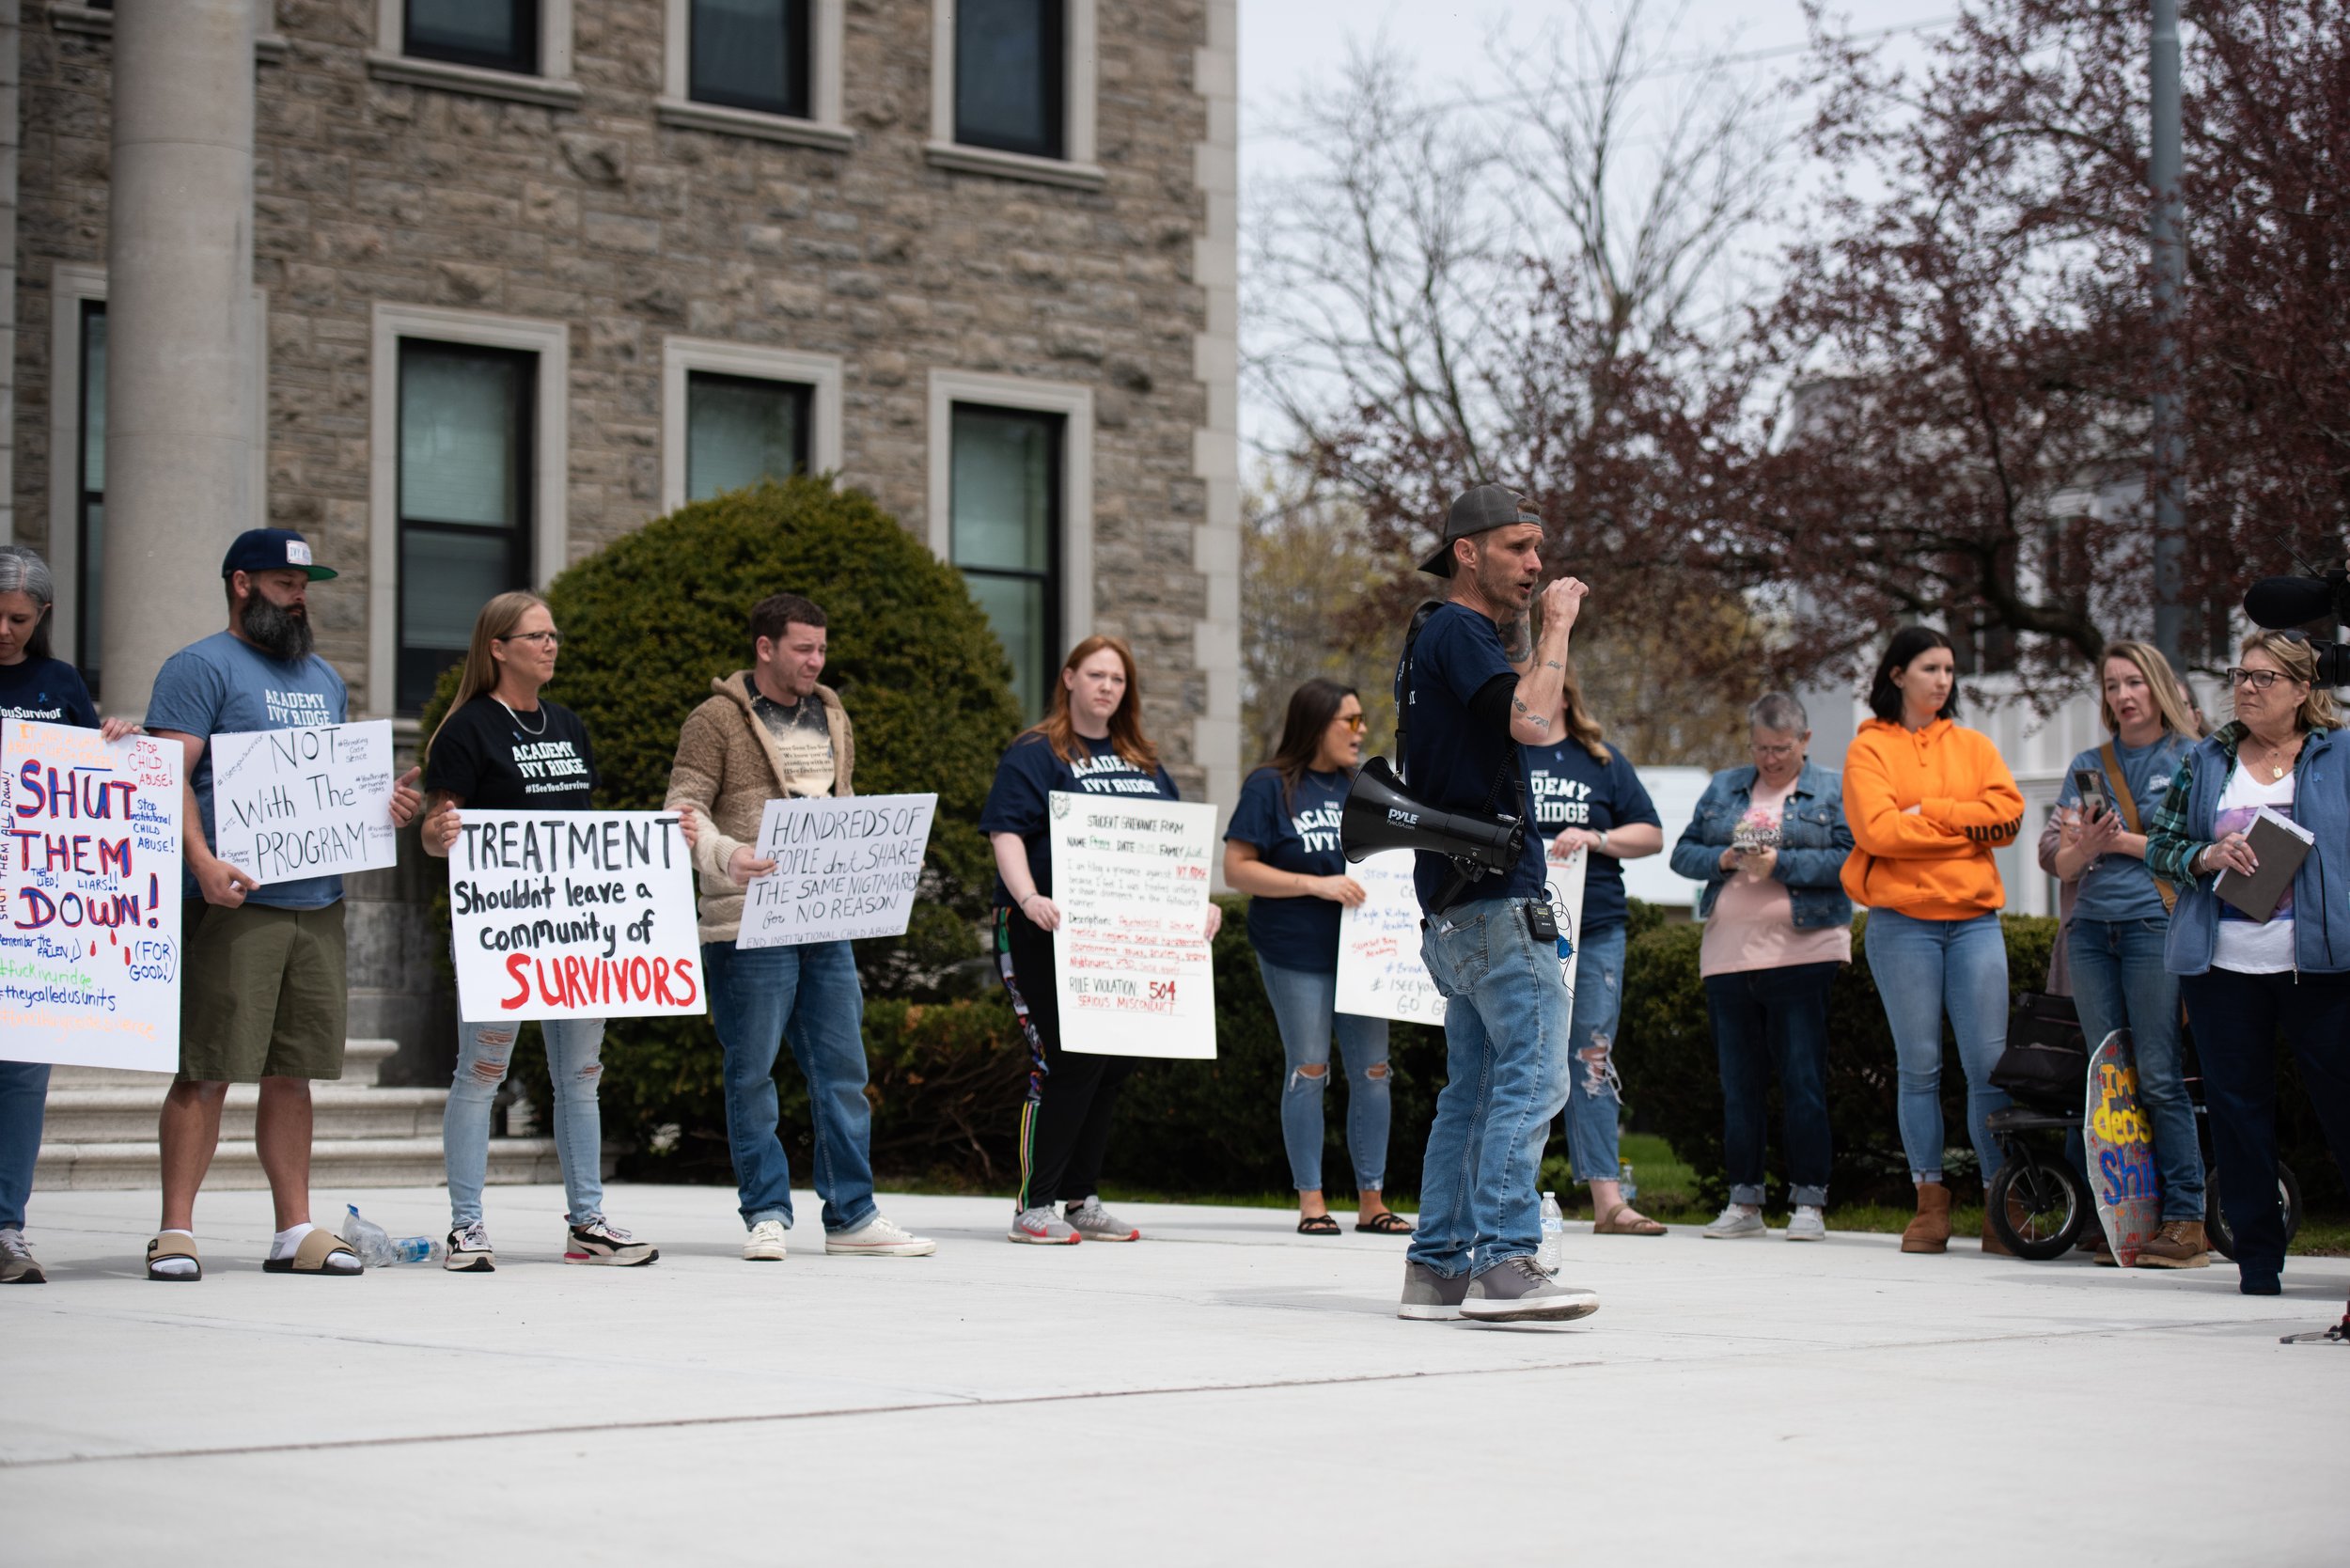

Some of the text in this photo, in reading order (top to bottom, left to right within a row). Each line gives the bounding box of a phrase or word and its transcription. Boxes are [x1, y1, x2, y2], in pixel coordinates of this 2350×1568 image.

[265, 688, 325, 709] ACADEMY
[267, 705, 332, 726] IVY RIDGE
[135, 741, 158, 754] STOP
[270, 727, 340, 774] NOT
[511, 741, 576, 761] ACADEMY
[128, 753, 163, 772] CHILD
[516, 758, 588, 778] IVY RIDGE
[1070, 754, 1147, 778] ACADEM
[138, 762, 173, 788] ABUSE!
[525, 779, 590, 794] #ISeeYouSurvivor
[1081, 778, 1112, 792] IVY
[16, 759, 137, 820] SHUT
[231, 774, 356, 828] With The
[1530, 777, 1592, 801] DEMY
[137, 798, 157, 812] Stop
[1388, 808, 1419, 824] PYLE
[1, 814, 12, 837] ALL
[133, 823, 161, 836] CHILD
[772, 806, 925, 846] HUNDREDS OF
[9, 829, 132, 878] THEM
[137, 837, 174, 854] ABUSE!
[256, 821, 367, 878] PROGRAM
[462, 820, 679, 873] TREATMENT
[1116, 839, 1136, 853] DATE
[1301, 832, 1336, 853] IVY
[0, 843, 10, 879] THEM
[766, 847, 820, 878] PEOPLE
[864, 838, 923, 870] SHARE
[37, 872, 59, 888] LIED!
[565, 877, 626, 907] leave
[635, 883, 652, 899] a
[755, 880, 794, 906] THE
[796, 876, 846, 900] SAME
[0, 888, 8, 920] SHUT
[14, 872, 159, 930] DOWN!
[761, 893, 900, 931] for NO REASON
[37, 933, 52, 948] the
[480, 908, 655, 958] community of
[745, 924, 903, 949] END INSTITUTIONAL CHILD ABUSE
[501, 952, 697, 1011] SURVIVORS
[1069, 976, 1089, 994] RULE
[1149, 980, 1176, 1001] 504
[1397, 995, 1420, 1014] GO
